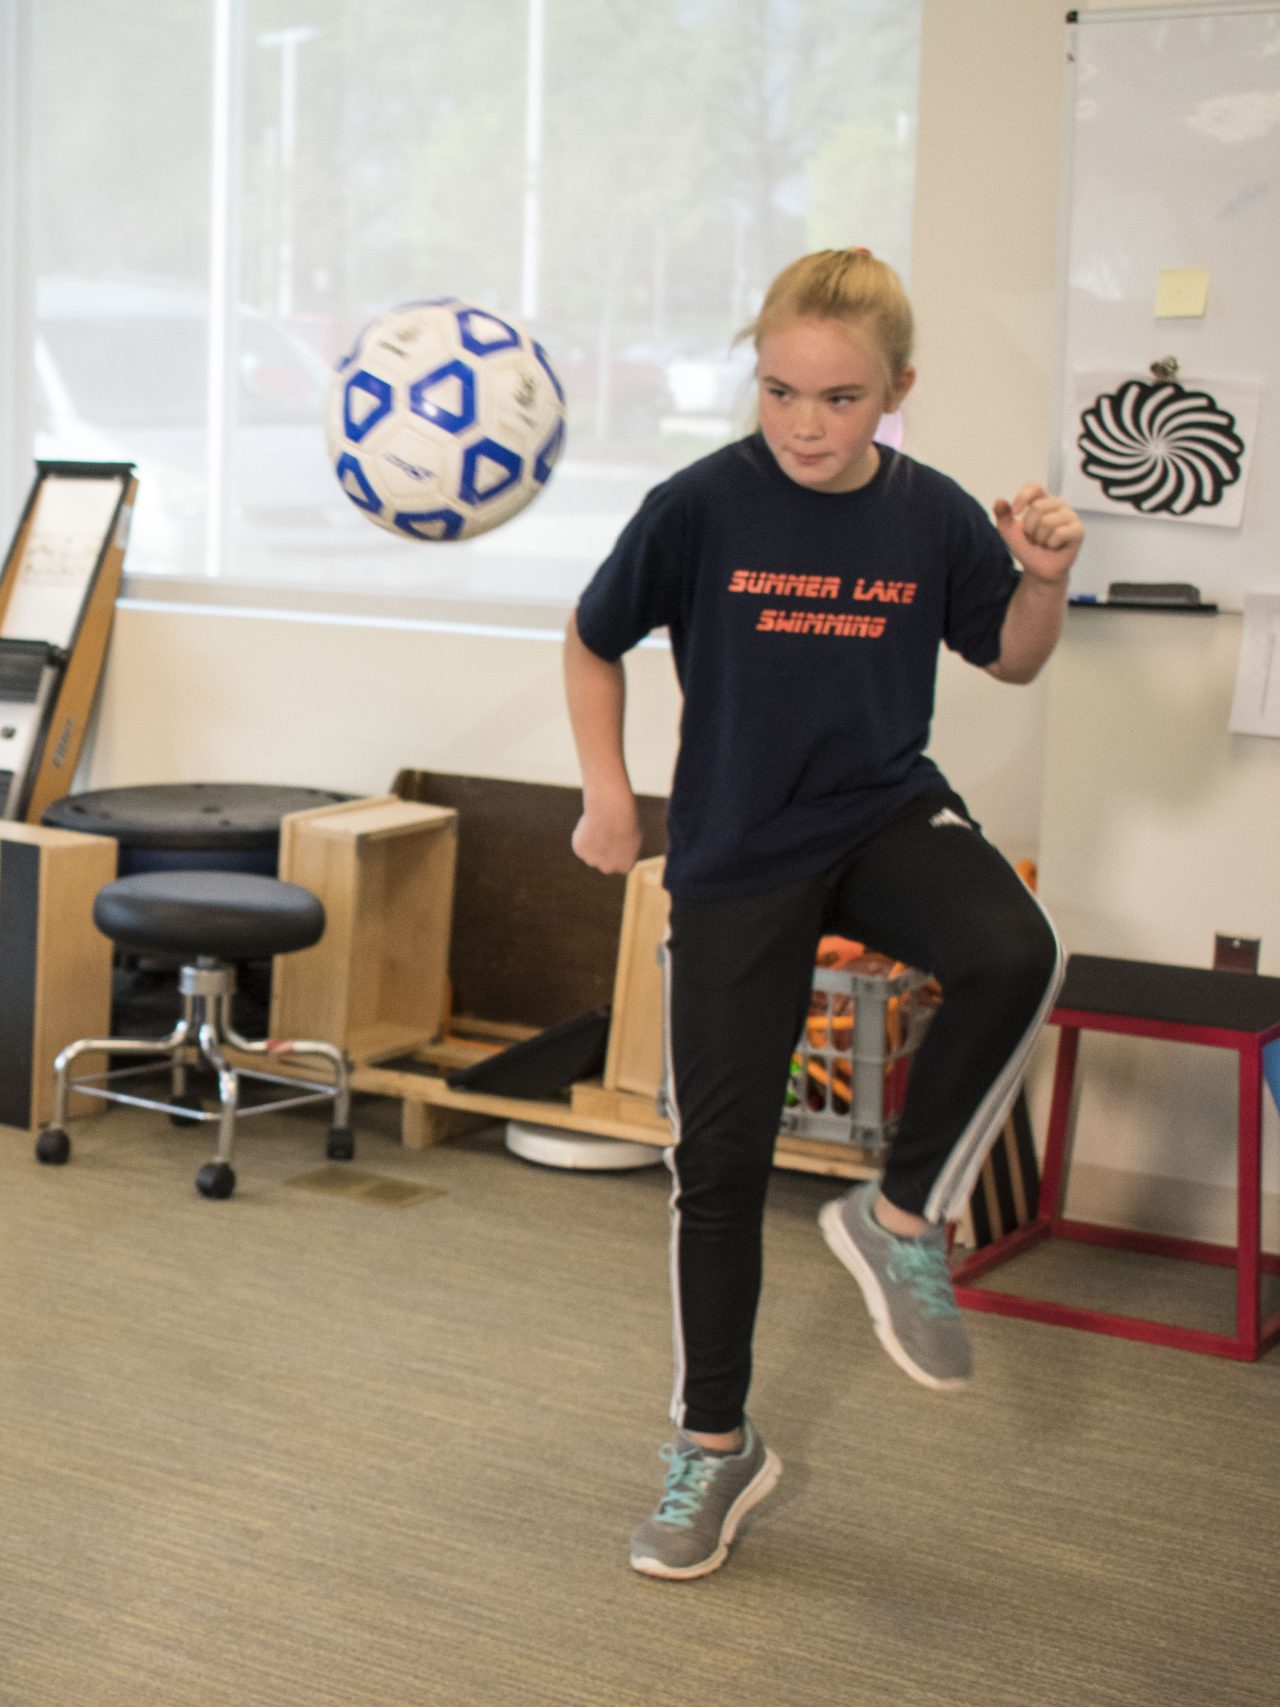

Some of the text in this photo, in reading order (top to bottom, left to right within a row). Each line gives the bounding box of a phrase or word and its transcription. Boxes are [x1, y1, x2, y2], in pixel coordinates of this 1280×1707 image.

[728, 569, 917, 604] SUMMER LAKE
[755, 608, 887, 638] SWIMMING
